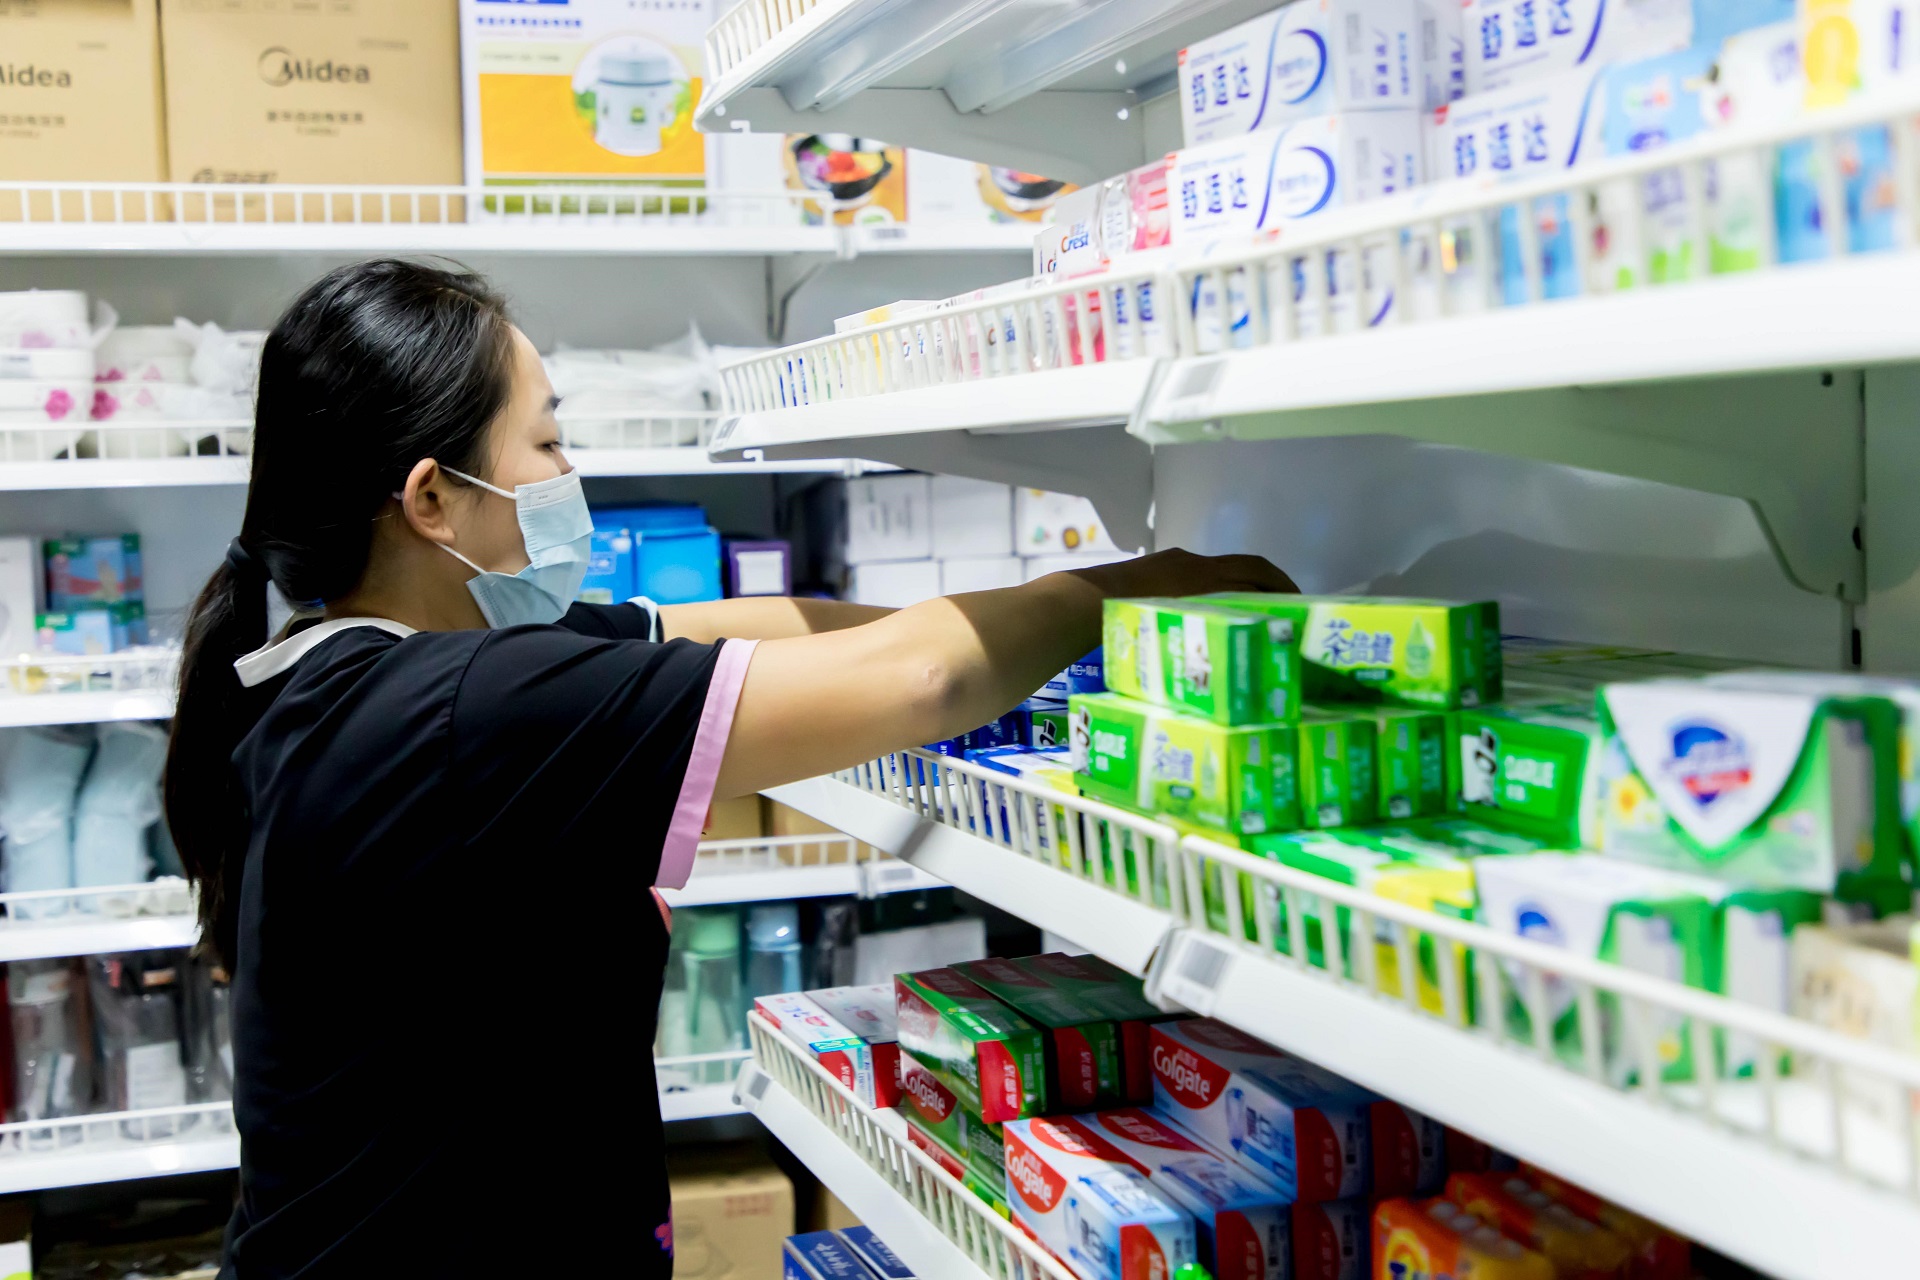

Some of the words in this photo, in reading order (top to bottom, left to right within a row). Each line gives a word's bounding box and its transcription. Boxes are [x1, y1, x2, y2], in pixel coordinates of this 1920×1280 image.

[272, 54, 371, 85] Midea
[1192, 58, 1250, 113] 舒适达
[1455, 113, 1547, 177] 舒适达
[1182, 168, 1248, 218] 舒适达
[1061, 231, 1089, 253] Crest
[1322, 619, 1394, 666] 茶倍健
[904, 1075, 945, 1117] Colgate
[1153, 1045, 1211, 1102] Colgate
[1005, 1144, 1053, 1208] Colgate
